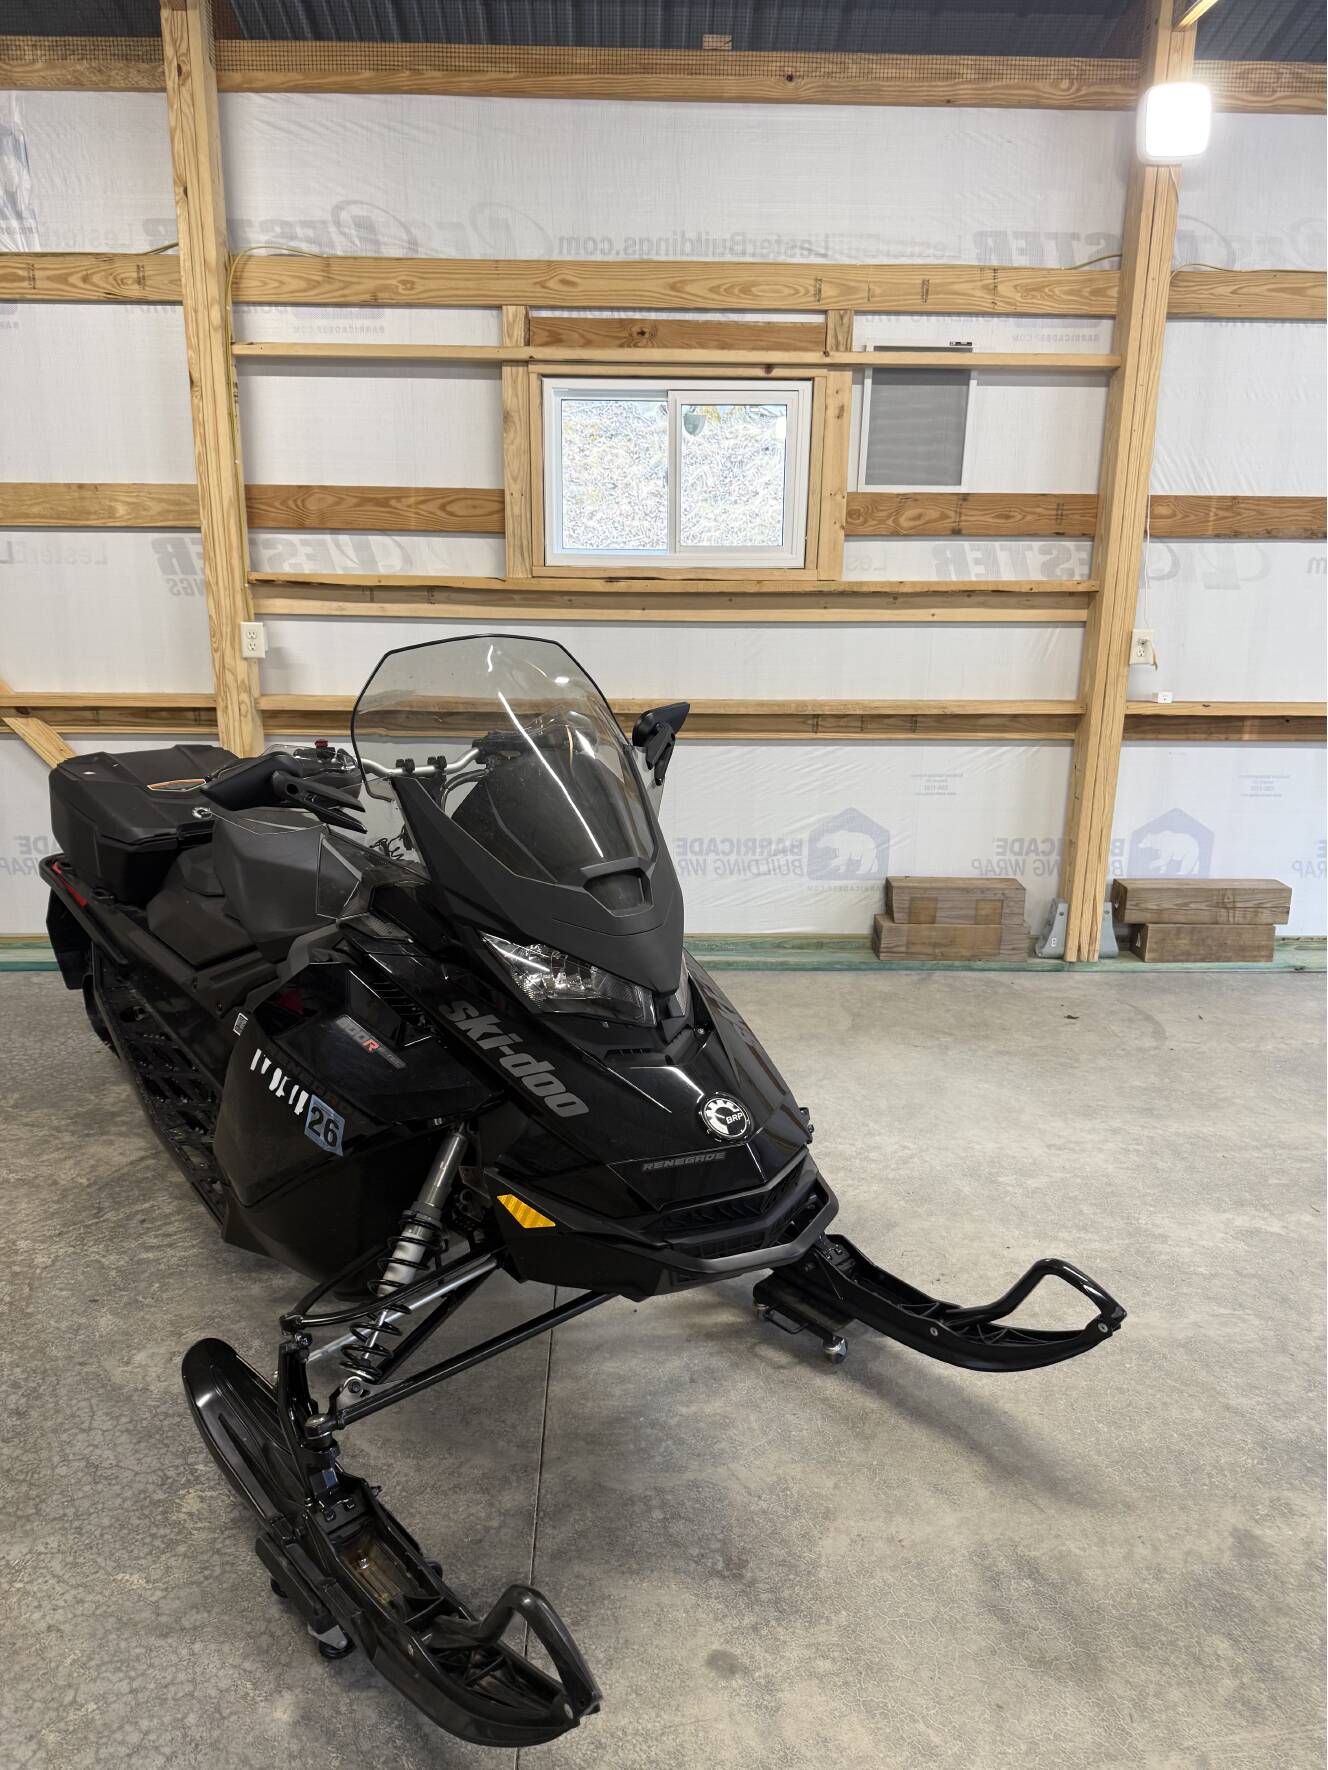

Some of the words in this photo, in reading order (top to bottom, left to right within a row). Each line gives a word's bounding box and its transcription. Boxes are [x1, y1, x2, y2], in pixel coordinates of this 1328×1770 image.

[307, 1105, 340, 1148] 26
[725, 1112, 744, 1125] BRP
[641, 1152, 727, 1172] RENEGADE
